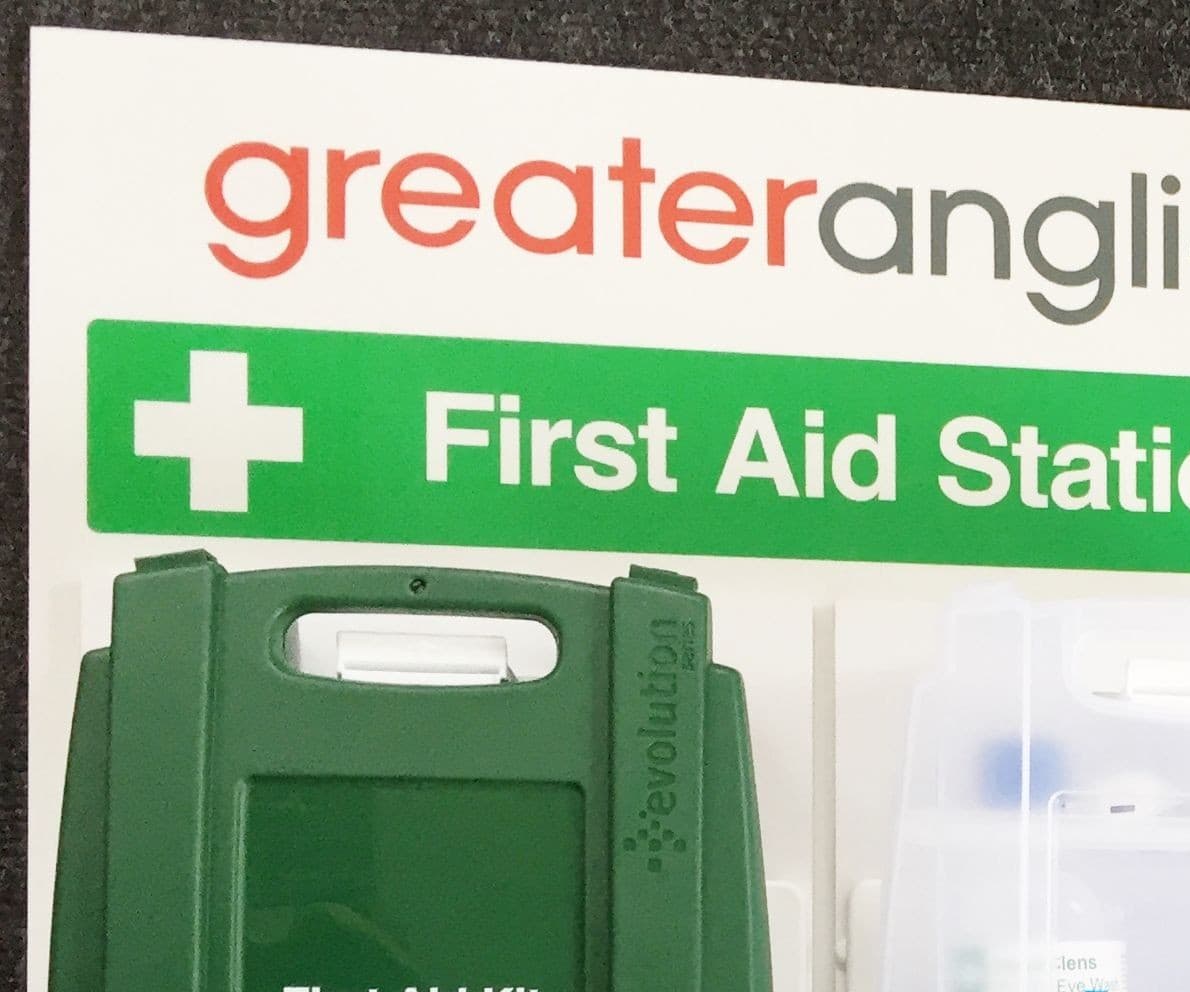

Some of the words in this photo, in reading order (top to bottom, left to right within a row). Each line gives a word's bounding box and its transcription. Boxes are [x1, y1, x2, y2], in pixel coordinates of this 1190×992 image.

[423, 390, 677, 495] First
[716, 405, 896, 502] Aid
[637, 618, 678, 817] evolution
